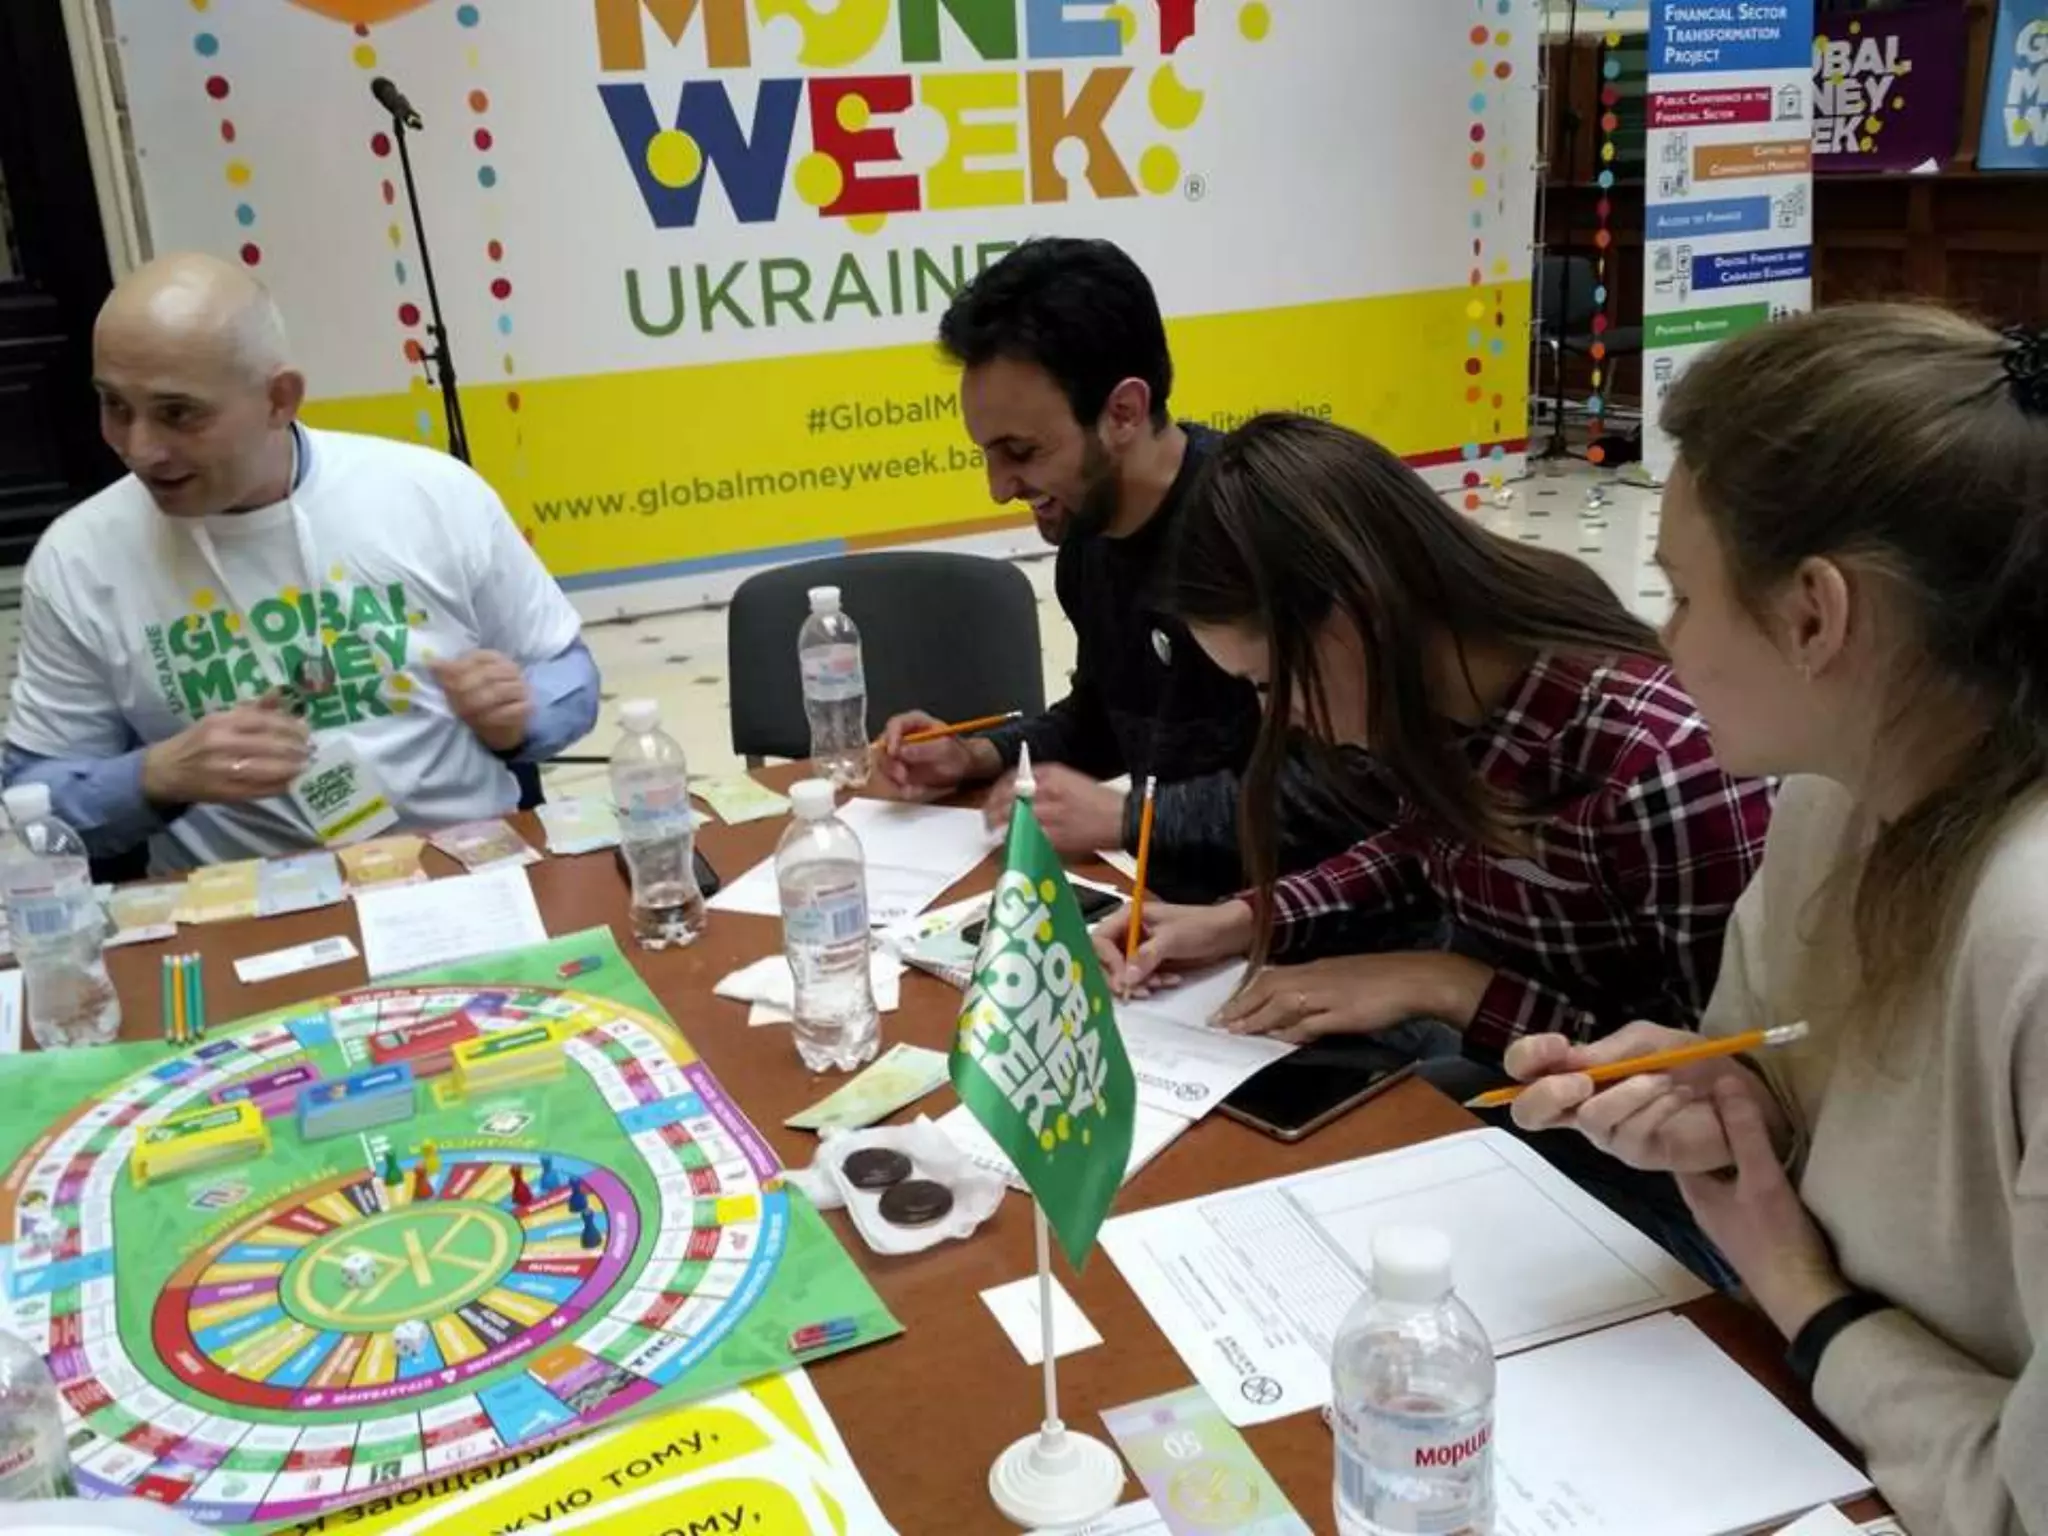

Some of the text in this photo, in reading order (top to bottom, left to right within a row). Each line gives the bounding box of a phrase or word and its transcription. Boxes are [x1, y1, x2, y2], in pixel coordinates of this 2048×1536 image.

[597, 66, 1139, 229] WEEK
[806, 392, 957, 434] #GlobalM
[532, 444, 984, 525] www.globalmoneyweek.ba
[168, 581, 429, 661] GLOBAL
[601, 1430, 719, 1489] тому,
